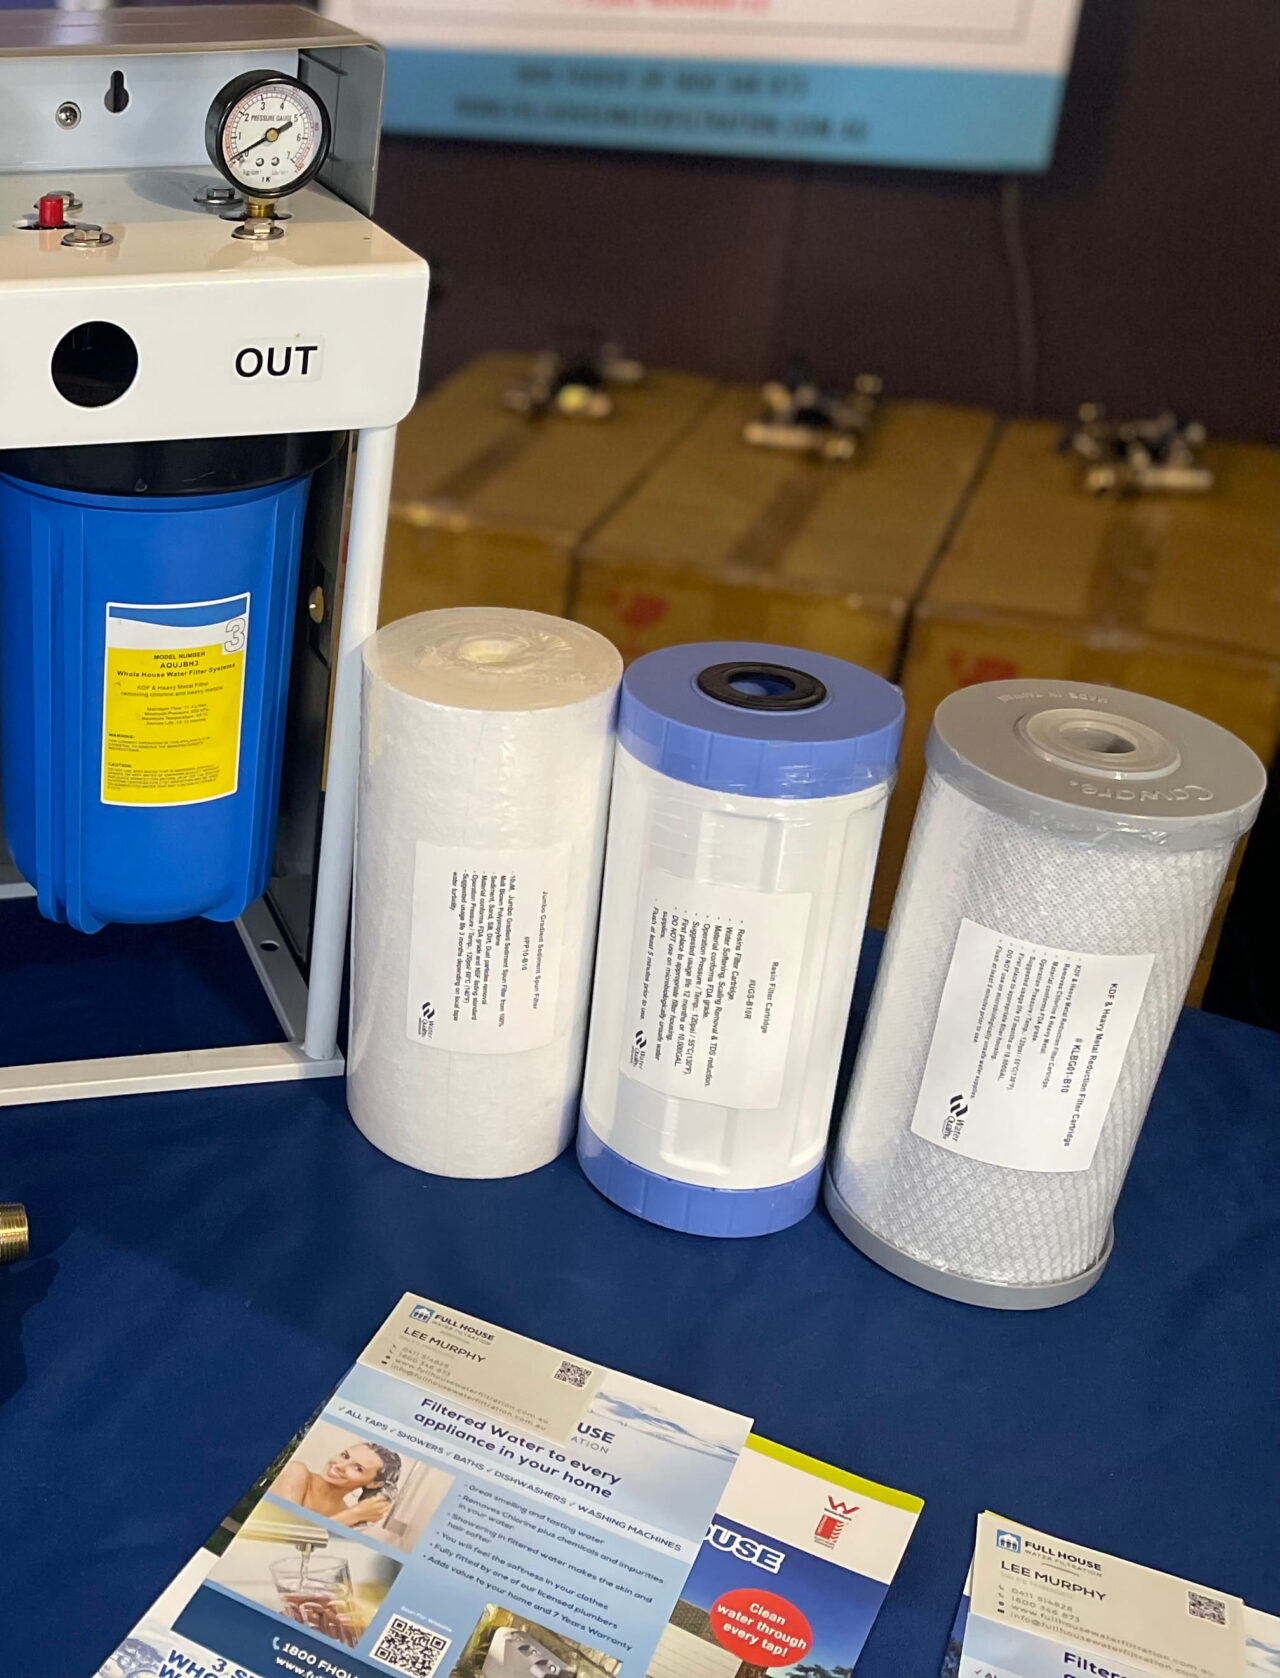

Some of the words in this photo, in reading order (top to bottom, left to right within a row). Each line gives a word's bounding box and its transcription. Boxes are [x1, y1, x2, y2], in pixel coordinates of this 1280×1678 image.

[235, 346, 318, 377] OUT
[224, 618, 245, 652] 3
[160, 661, 199, 669] AQUJBH3
[189, 668, 208, 676] Filter
[209, 663, 236, 674] Systems
[538, 914, 546, 942] Gradient
[770, 962, 778, 981] Resin
[767, 983, 775, 1000] Filter
[1108, 983, 1118, 998] KDF
[760, 1002, 772, 1033] Cartridge
[1096, 1009, 1110, 1031] Heavy
[1092, 1033, 1103, 1053] Metal
[1061, 1044, 1081, 1093] KLBG01-B10
[1080, 1055, 1096, 1092] Reduction
[1075, 1093, 1085, 1112] Filter
[952, 1118, 965, 1142] Water
[1064, 1114, 1079, 1146] Cartridge
[434, 1314, 457, 1327] FULL
[460, 1324, 494, 1340] HOUSE
[404, 1327, 428, 1341] LEE
[429, 1337, 485, 1362] MURPHY
[421, 1398, 486, 1430] Filtered
[491, 1425, 544, 1452] Water
[549, 1450, 566, 1462] to
[570, 1460, 620, 1485] every
[570, 1436, 608, 1454] ATION
[577, 1422, 615, 1444] USE
[414, 1414, 495, 1450] appliance
[499, 1445, 514, 1459] in
[518, 1456, 559, 1475] your
[563, 1472, 611, 1498] home
[345, 1410, 361, 1420] ALL
[365, 1417, 388, 1430] TAPS
[397, 1431, 443, 1453] SHOWERS
[453, 1454, 484, 1470] BATHS
[494, 1470, 566, 1504] DISHWASHERS
[578, 1505, 626, 1528] WASHING
[628, 1525, 681, 1551] MACHINES
[469, 1485, 492, 1498] Great
[494, 1496, 527, 1514] smelling
[528, 1510, 545, 1519] and
[546, 1517, 576, 1534] tasting
[578, 1531, 604, 1544] water
[462, 1495, 500, 1514] Removes
[502, 1512, 536, 1530] Chlorine
[537, 1528, 555, 1538] plus
[557, 1536, 598, 1556] chemicals
[600, 1554, 618, 1564] and
[619, 1562, 663, 1583] impurities
[705, 1524, 786, 1574] USE
[442, 1532, 456, 1543] You
[458, 1541, 472, 1549] will
[474, 1547, 490, 1557] feel
[491, 1555, 505, 1564] the
[507, 1562, 544, 1582] softness
[545, 1578, 553, 1586] in
[555, 1584, 575, 1594] your
[576, 1593, 608, 1610] clothes
[452, 1513, 496, 1538] Showering
[507, 1537, 539, 1554] filtered
[540, 1553, 566, 1566] water
[568, 1564, 597, 1580] makes
[599, 1577, 613, 1586] the
[615, 1585, 632, 1594] skin
[634, 1593, 653, 1603] and
[1025, 1541, 1055, 1556] FULL
[1058, 1551, 1102, 1571] HOUSE
[434, 1544, 453, 1557] Fully
[455, 1553, 480, 1567] fitted
[480, 1564, 491, 1573] by
[492, 1571, 508, 1580] one
[520, 1583, 536, 1592] our
[537, 1589, 574, 1609] licensed
[574, 1607, 617, 1629] plumbers
[1001, 1561, 1031, 1577] LEE
[1035, 1571, 1106, 1600] MURPHY
[427, 1556, 449, 1569] Adds
[451, 1567, 474, 1580] value
[476, 1577, 484, 1585] to
[486, 1583, 506, 1594] your
[507, 1591, 532, 1606] home
[534, 1604, 552, 1615] and
[562, 1614, 585, 1630] Years
[588, 1626, 632, 1651] Warranty
[749, 1603, 786, 1625] Clean
[717, 1604, 754, 1625] water
[756, 1621, 807, 1649] through
[723, 1623, 759, 1644] every
[762, 1639, 788, 1656] tap!
[282, 1643, 317, 1665] 1800
[1064, 1652, 1127, 1678] Filter
